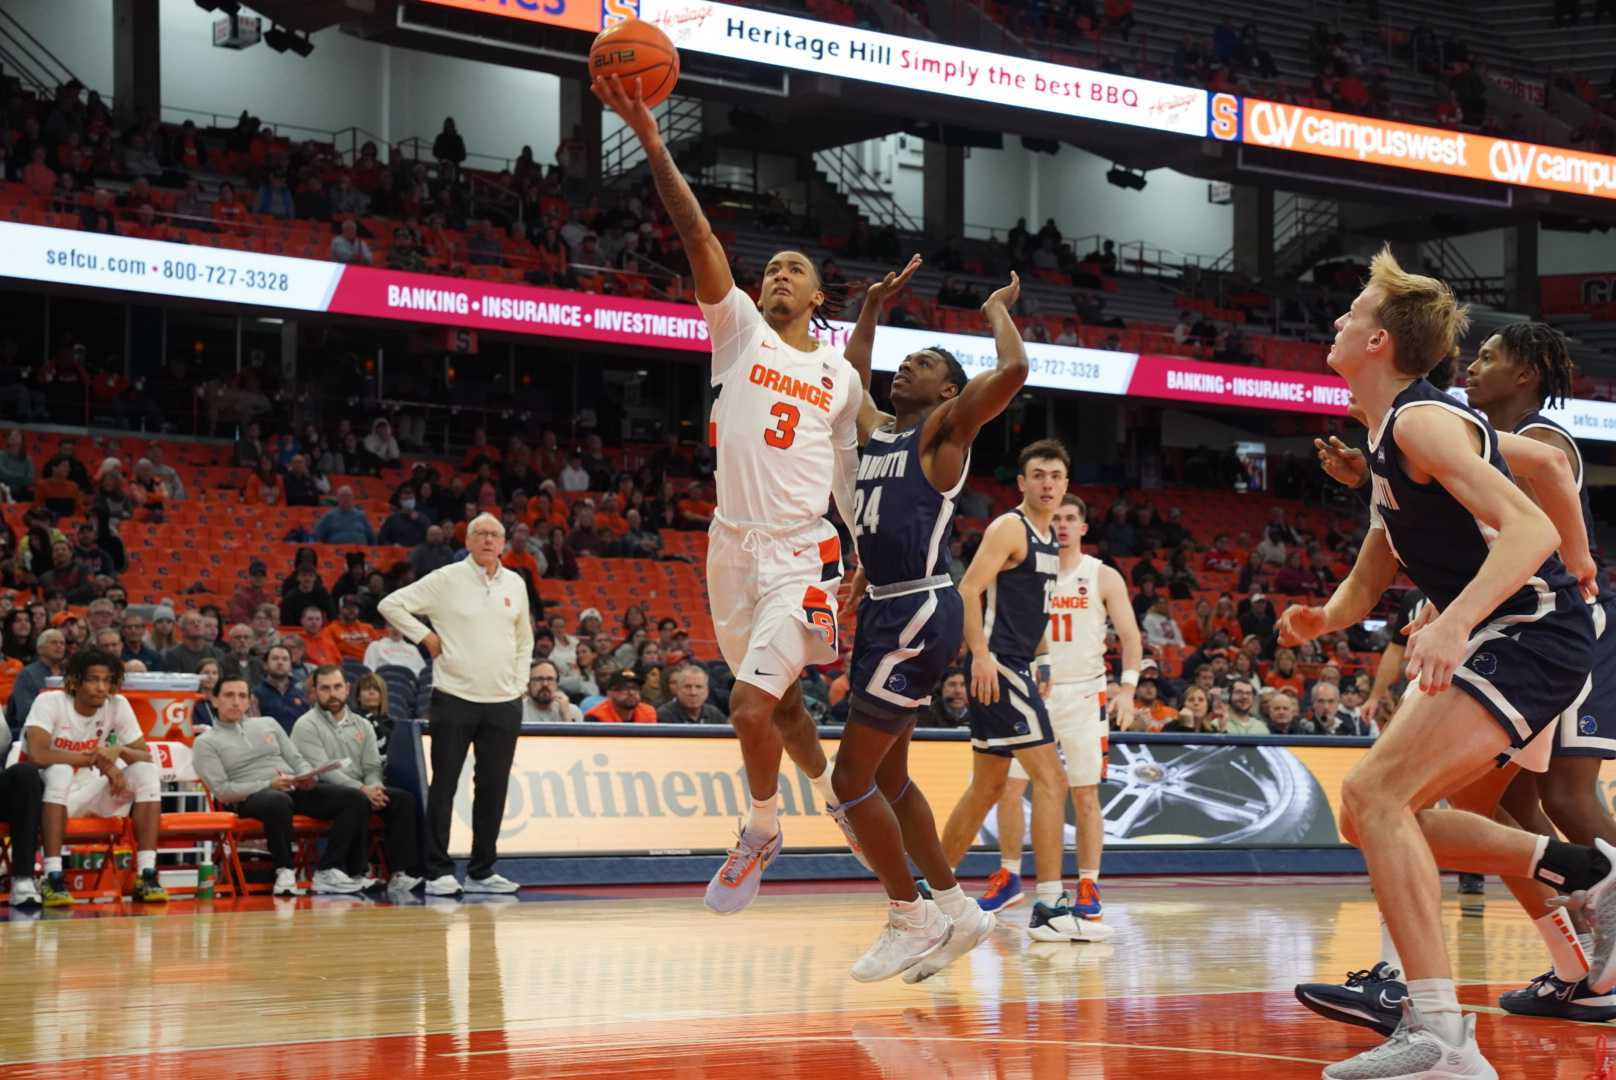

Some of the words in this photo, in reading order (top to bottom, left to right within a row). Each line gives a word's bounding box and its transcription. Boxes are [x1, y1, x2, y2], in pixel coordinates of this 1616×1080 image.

[726, 17, 844, 57] Heritage
[849, 40, 892, 66] Hill
[900, 49, 980, 86] Simply
[988, 67, 1026, 88] the
[1034, 74, 1082, 99] best
[1090, 83, 1139, 107] BBQ
[1211, 92, 1238, 141] S
[1302, 115, 1467, 166] campuswest
[46, 248, 147, 276] sefcu.com
[163, 260, 289, 292] 800-727-3328
[387, 284, 469, 315] BANKING
[482, 296, 582, 328] INSURANCE
[594, 308, 709, 340] INVESTMENTS
[749, 363, 833, 413] ORANGE
[1031, 357, 1100, 379] 0-727-3328
[1166, 370, 1225, 394] BANKING
[1232, 377, 1305, 402] INSURANCE
[764, 401, 800, 449] 3
[855, 485, 883, 534] 24
[1049, 613, 1073, 642] 11
[166, 702, 186, 725] G
